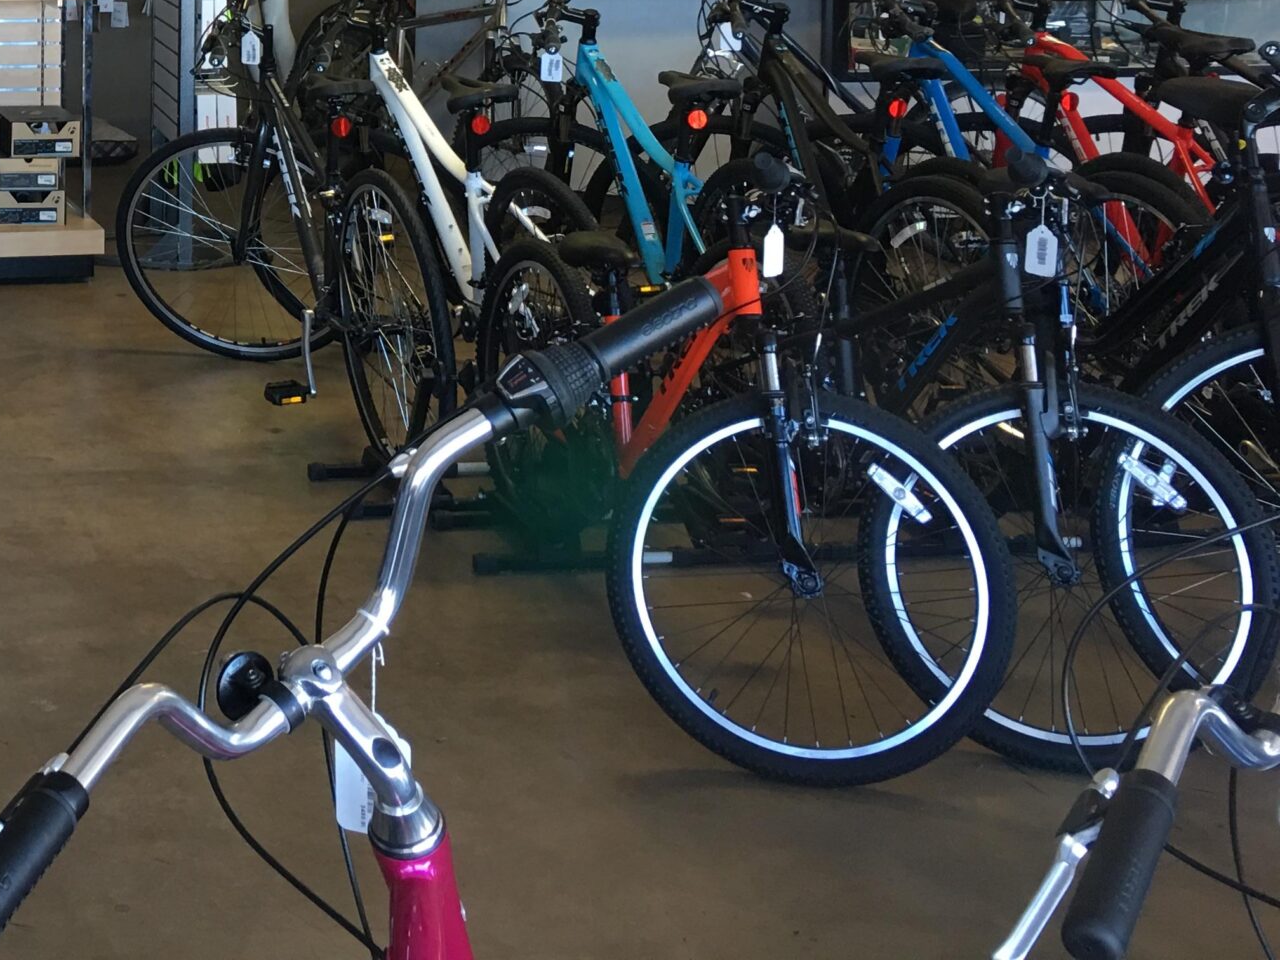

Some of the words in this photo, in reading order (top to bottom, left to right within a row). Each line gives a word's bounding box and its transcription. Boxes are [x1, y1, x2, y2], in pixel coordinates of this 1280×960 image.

[272, 127, 302, 219] TREK
[1152, 270, 1221, 350] TREK
[897, 313, 959, 393] TREK
